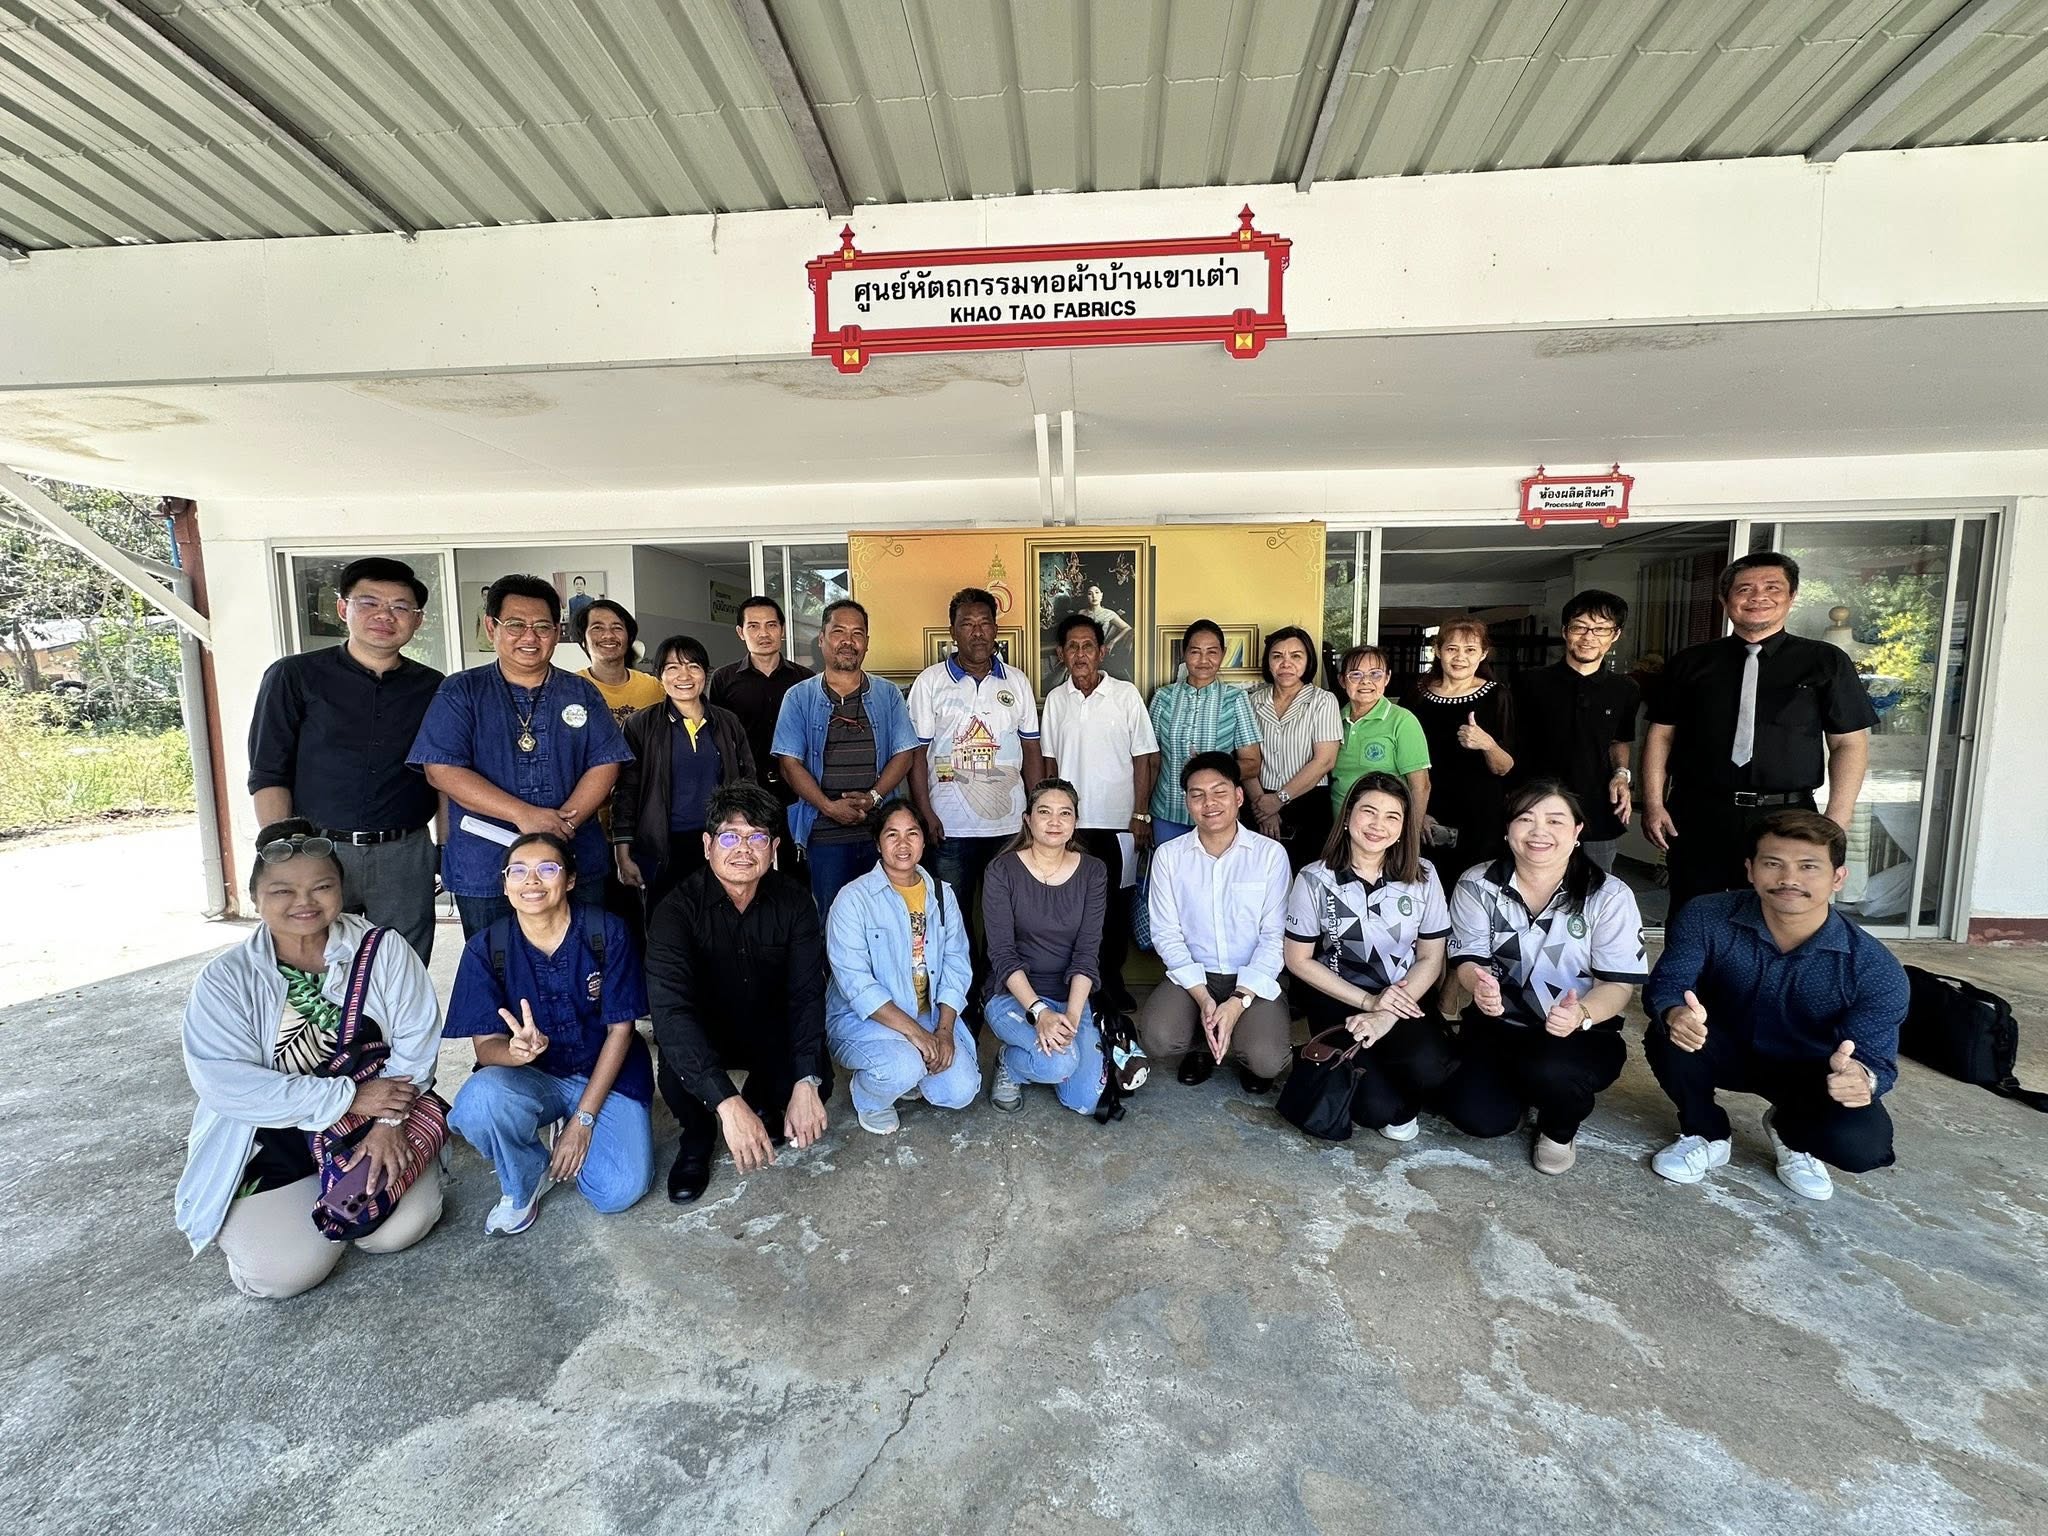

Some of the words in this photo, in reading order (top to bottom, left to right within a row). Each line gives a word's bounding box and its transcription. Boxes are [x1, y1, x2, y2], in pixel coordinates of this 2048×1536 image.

[854, 257, 1239, 313] ศูนย์หัตถกรรมทอผ้าบ้านเขาเต่า
[950, 305, 1002, 323] KHAO
[1009, 303, 1046, 320] TAO
[1053, 300, 1137, 319] FABRICS
[1539, 485, 1615, 499] ห้องผลิตสินค้า
[1544, 501, 1584, 509] Processing
